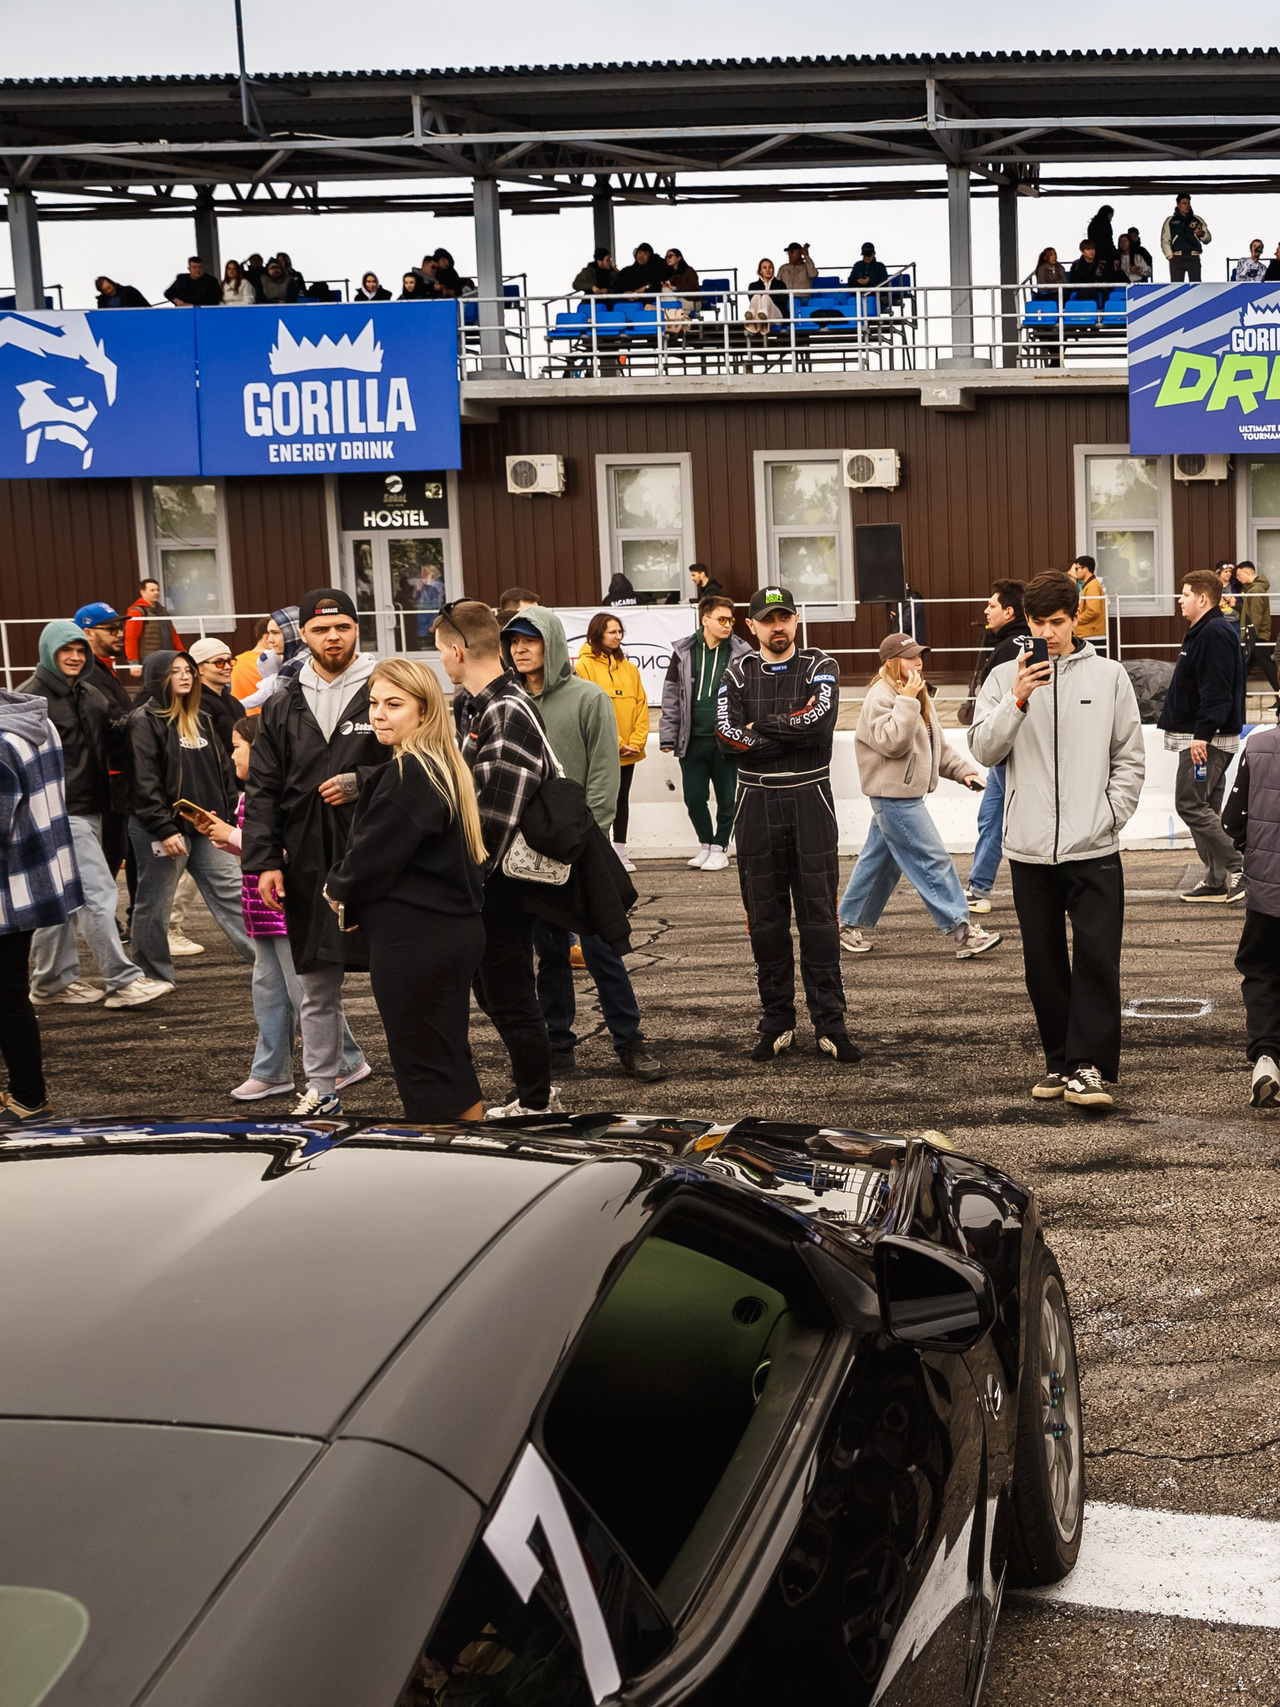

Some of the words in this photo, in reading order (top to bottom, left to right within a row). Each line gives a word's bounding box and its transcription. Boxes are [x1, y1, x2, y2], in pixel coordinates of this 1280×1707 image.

[243, 377, 417, 437] GORILLA
[1238, 425, 1277, 433] ULTIMATE
[268, 442, 337, 463] ENERGY
[340, 440, 395, 460] DRINK
[363, 509, 429, 527] HOSTEL
